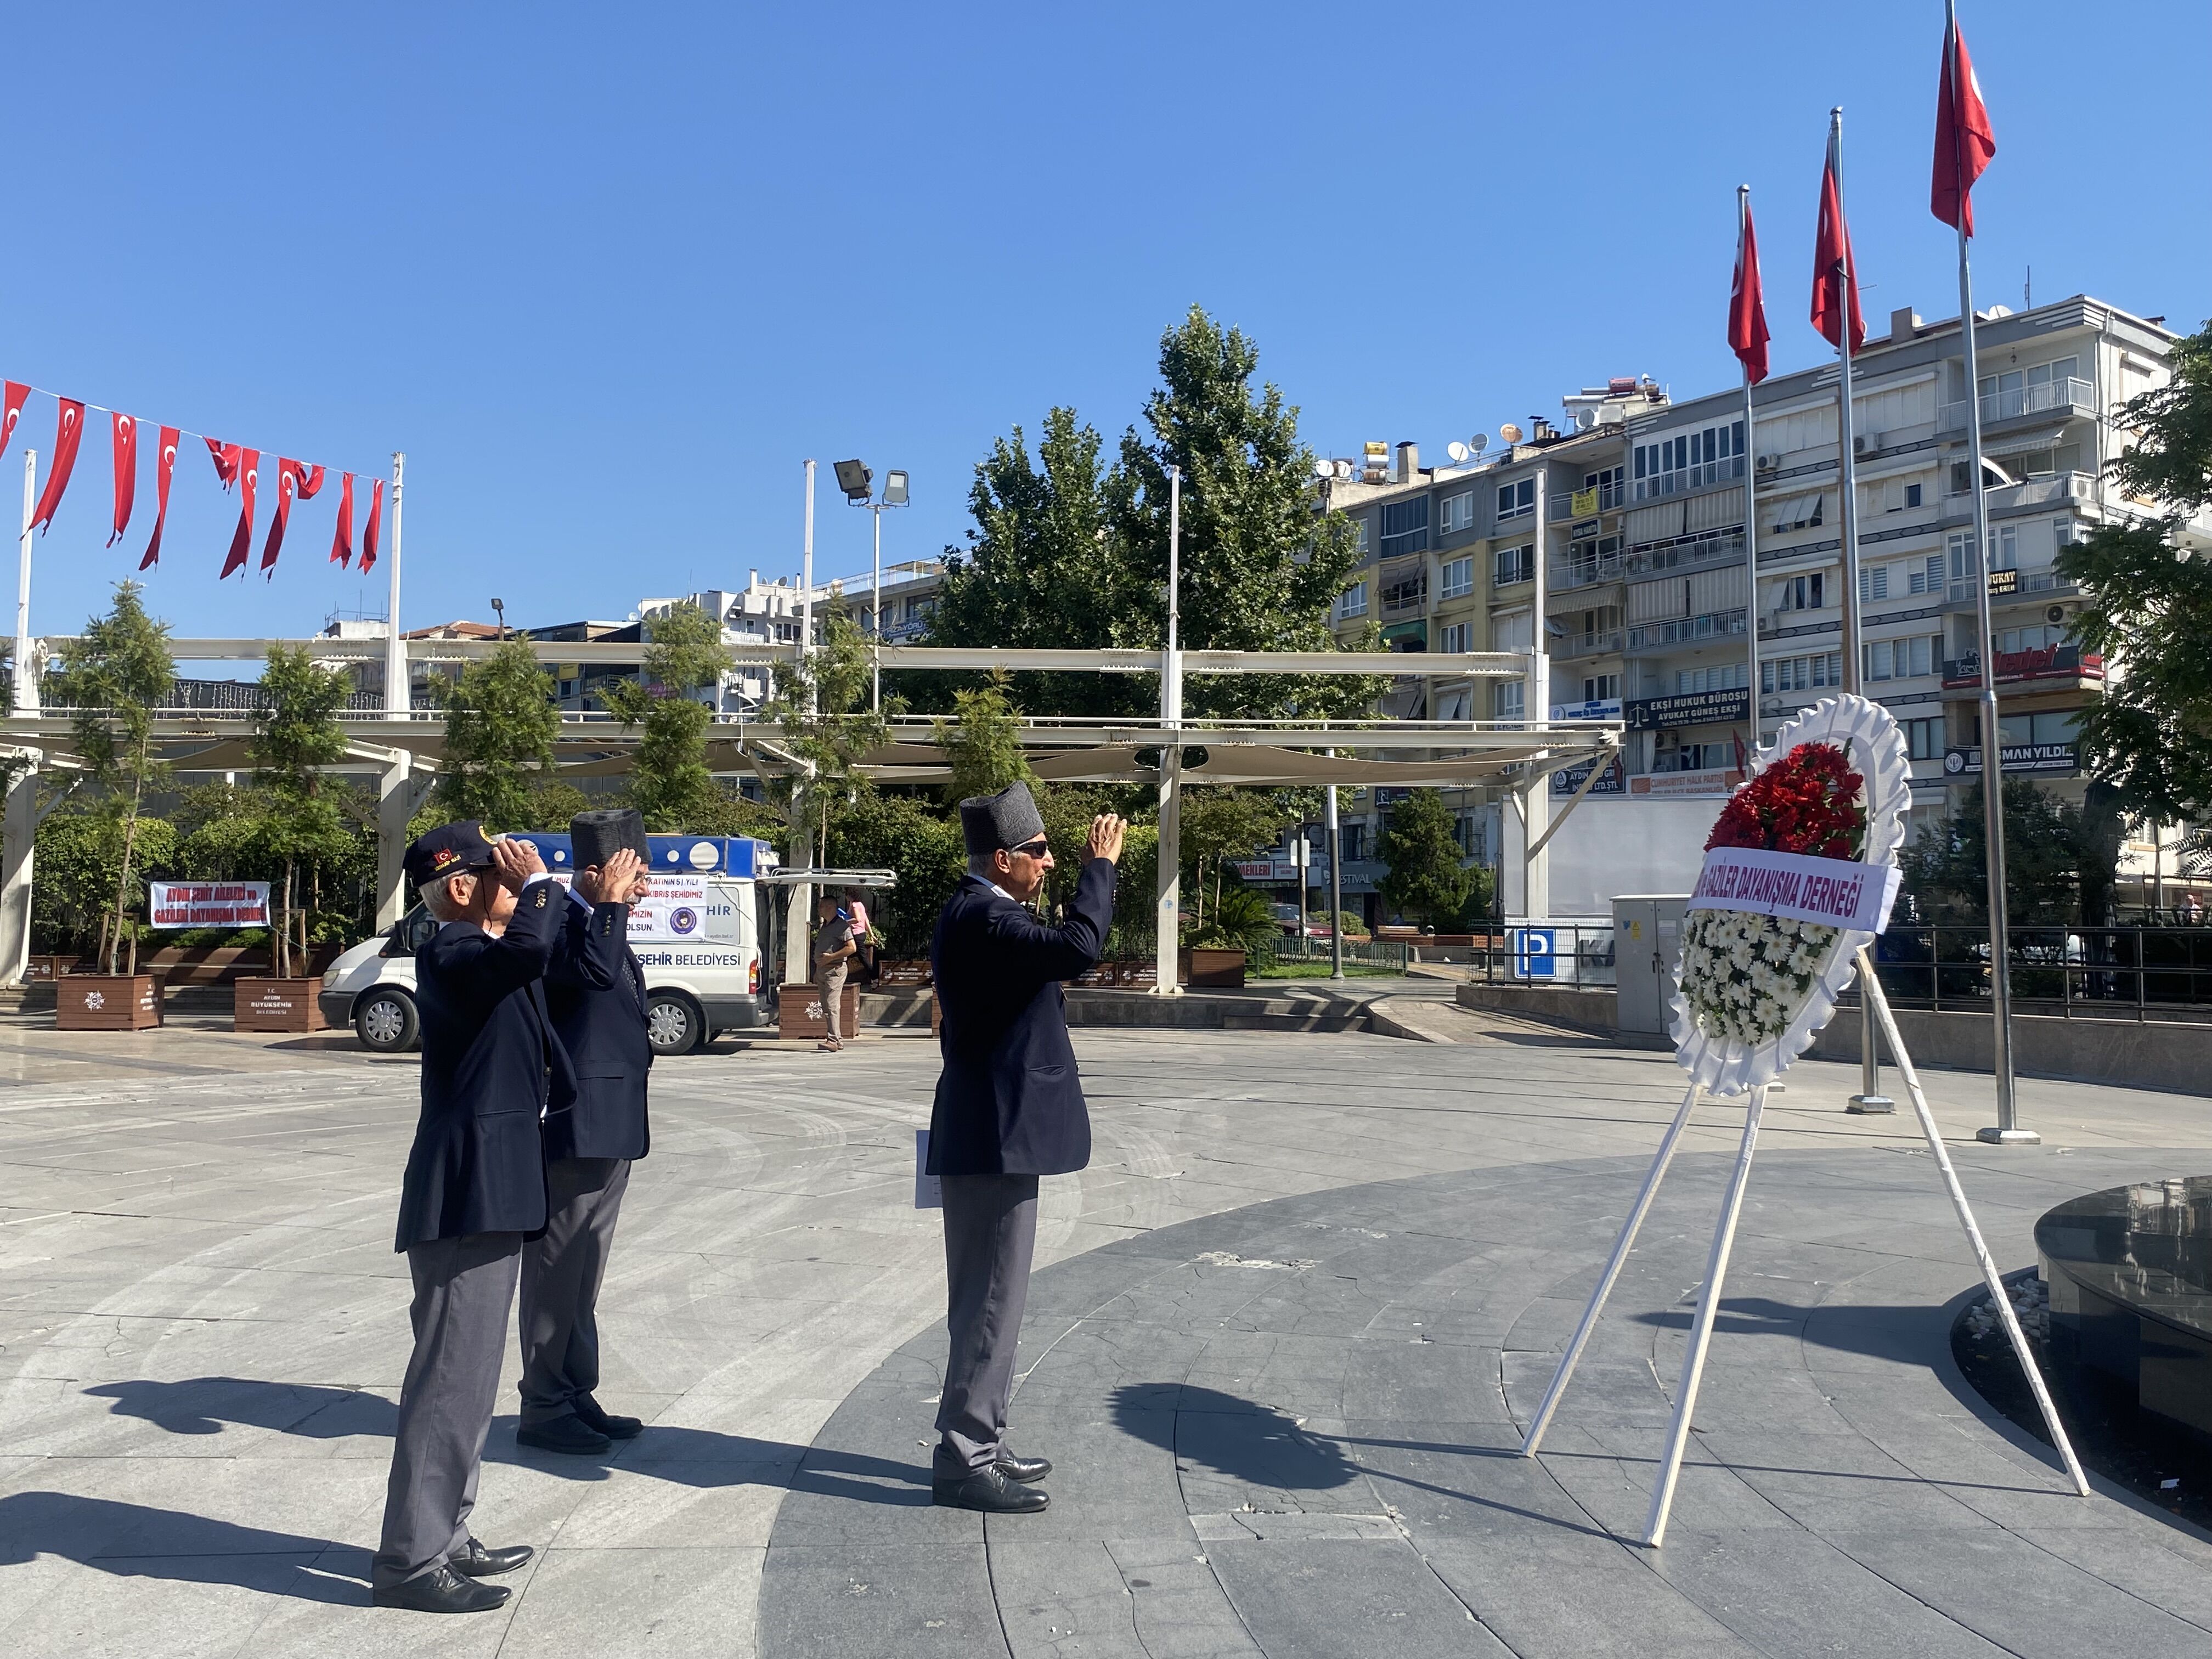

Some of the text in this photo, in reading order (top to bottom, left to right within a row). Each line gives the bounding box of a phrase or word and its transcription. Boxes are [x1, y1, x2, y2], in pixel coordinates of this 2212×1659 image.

[1650, 691, 1747, 712] EKŞİ HUKUK BÜROSU
[1658, 710, 1689, 720] AVUKAT
[1691, 707, 1718, 717] GÜNEŞ
[1721, 703, 1740, 713] EKŞİ
[2000, 748, 2032, 760] MAN
[1686, 775, 1703, 785] HALK
[1239, 862, 1271, 876] MEKLERİ
[1339, 874, 1370, 884] ESTIVAL
[670, 889, 703, 899] ŞEHİDİMİZ
[1706, 857, 1739, 899] GAZİLER
[1736, 866, 1802, 913] DAYANIŞMA
[1799, 873, 1864, 918] DERNEĞİ
[236, 903, 266, 923] DERNEĞ
[707, 903, 731, 916] HİR
[635, 951, 741, 968] ŞEHİR BELEDİYESİ
